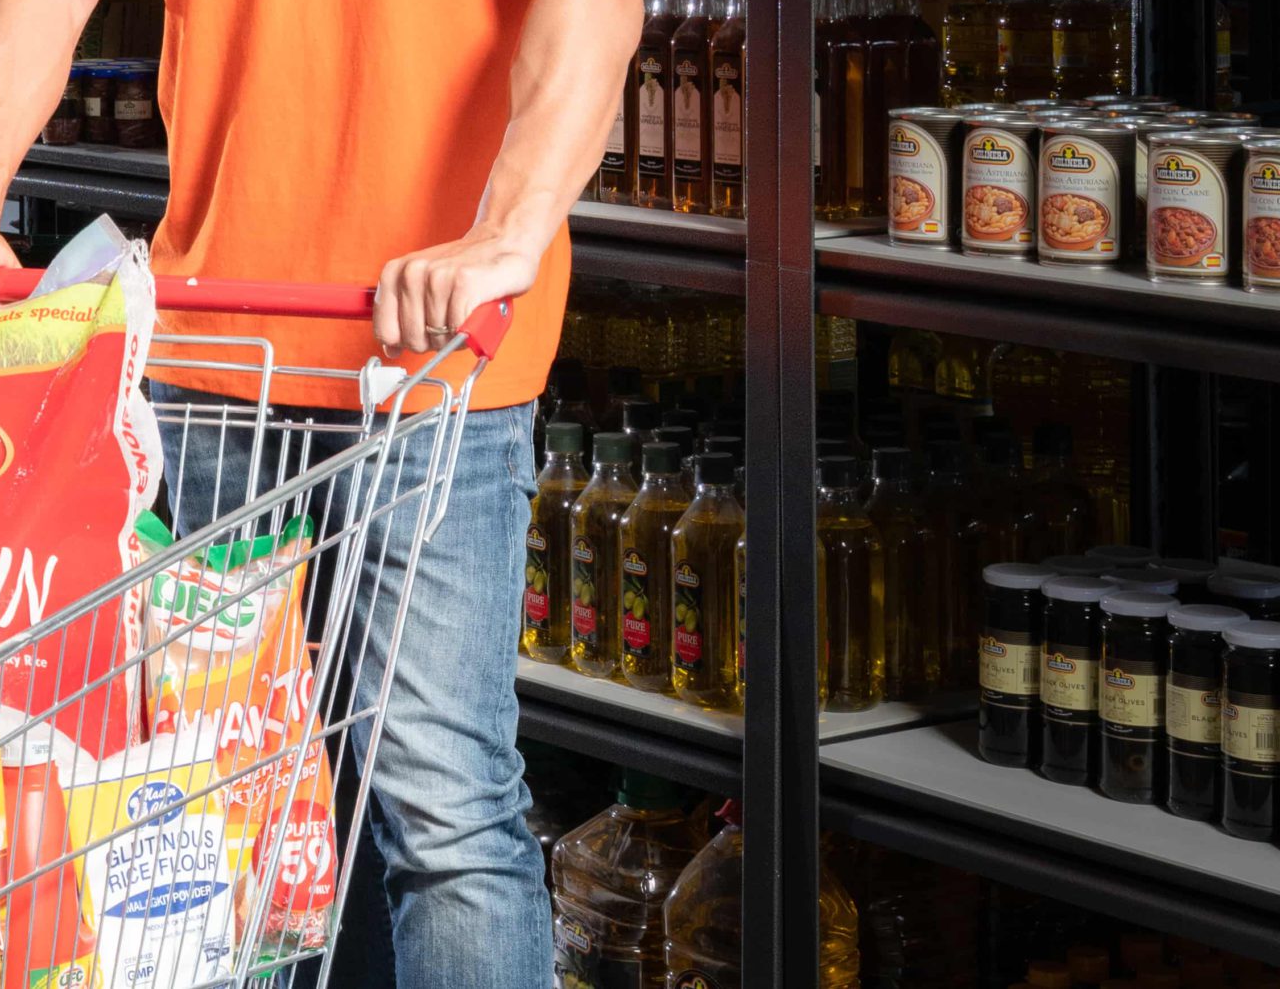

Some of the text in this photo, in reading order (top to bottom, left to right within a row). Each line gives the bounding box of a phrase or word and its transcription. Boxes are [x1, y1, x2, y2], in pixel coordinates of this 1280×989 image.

[972, 148, 1009, 160] MOLINERA
[897, 159, 934, 170] ASTURIANA
[1051, 156, 1089, 168] MOLINERA
[985, 167, 1028, 177] ASTURIANA
[1156, 168, 1194, 180] MOLINERA
[1066, 176, 1111, 186] ASTURIANA
[1181, 186, 1211, 197] CARNE
[527, 592, 545, 606] PURE
[574, 605, 592, 619] PURE
[625, 619, 646, 632] PURE
[677, 631, 698, 644] PURE
[1058, 682, 1086, 691] OLIVES
[1120, 697, 1146, 706] OLIVES
[108, 829, 214, 869] GLUTINOUS
[108, 853, 217, 894] RICE FLOUR
[127, 965, 155, 981] GMP
